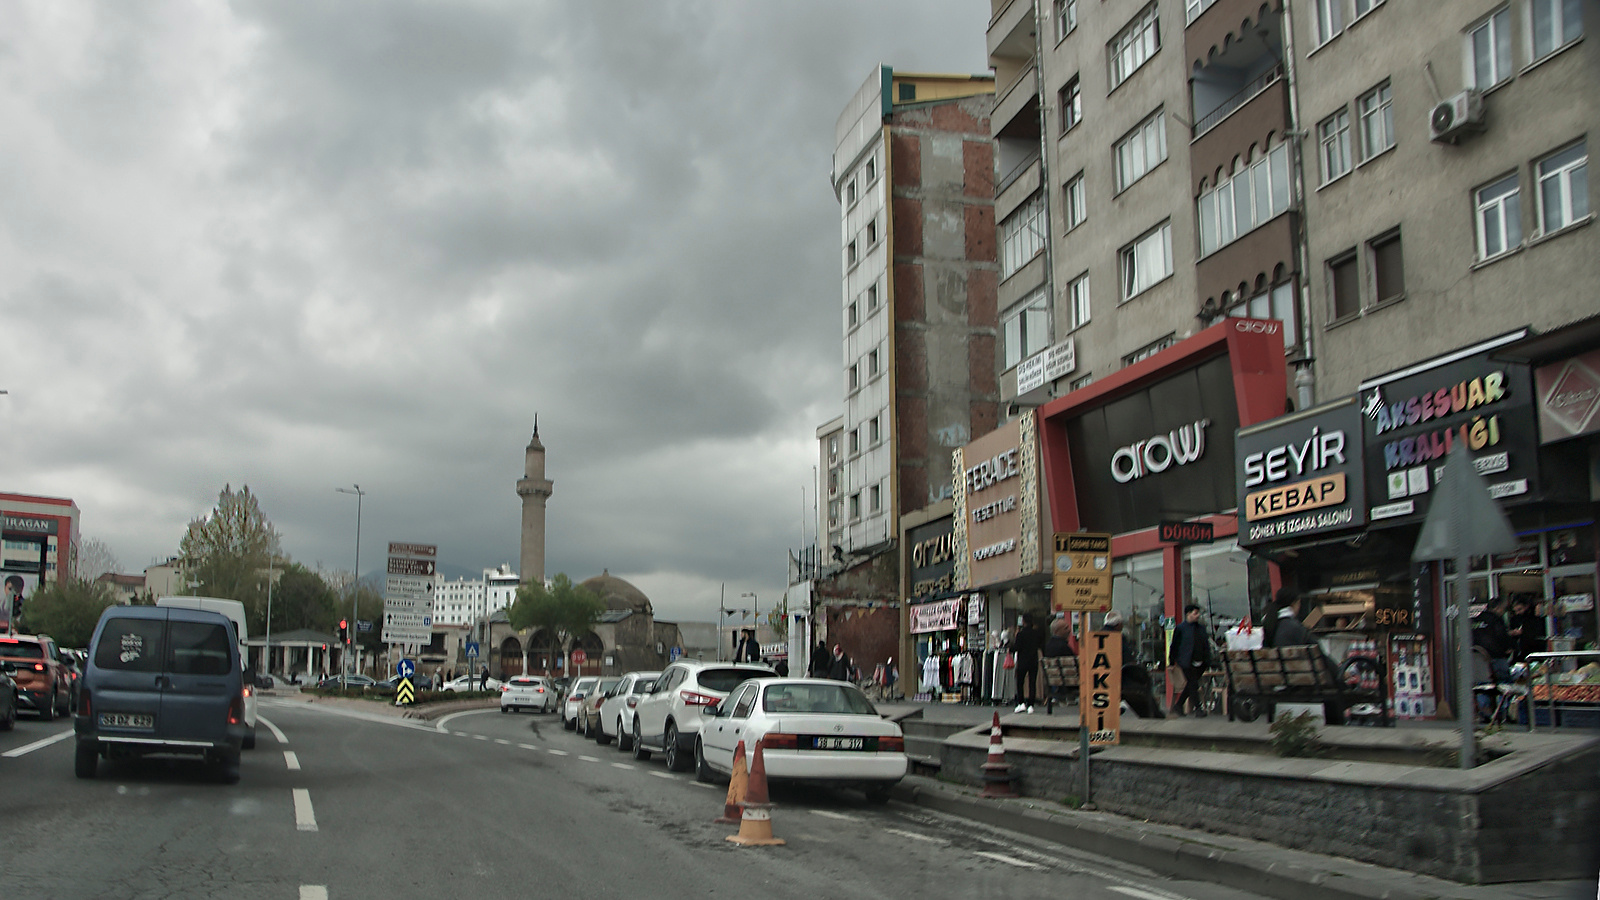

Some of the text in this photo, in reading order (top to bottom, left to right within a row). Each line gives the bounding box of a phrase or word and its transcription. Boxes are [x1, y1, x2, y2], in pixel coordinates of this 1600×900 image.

[1376, 370, 1506, 436] AKSESUAR
[966, 447, 1020, 496] FERACE
[1111, 420, 1206, 483] arow
[1244, 425, 1346, 488] SEYİR
[1254, 481, 1336, 516] KEBAP
[1163, 523, 1212, 540] DÜRÜM
[1249, 523, 1276, 540] DÖNER
[1276, 520, 1286, 534] VE
[1287, 515, 1318, 533] IZGARA
[1318, 508, 1353, 527] SALONU
[572, 653, 586, 661] DUR
[1092, 634, 1111, 731] TAKSİ
